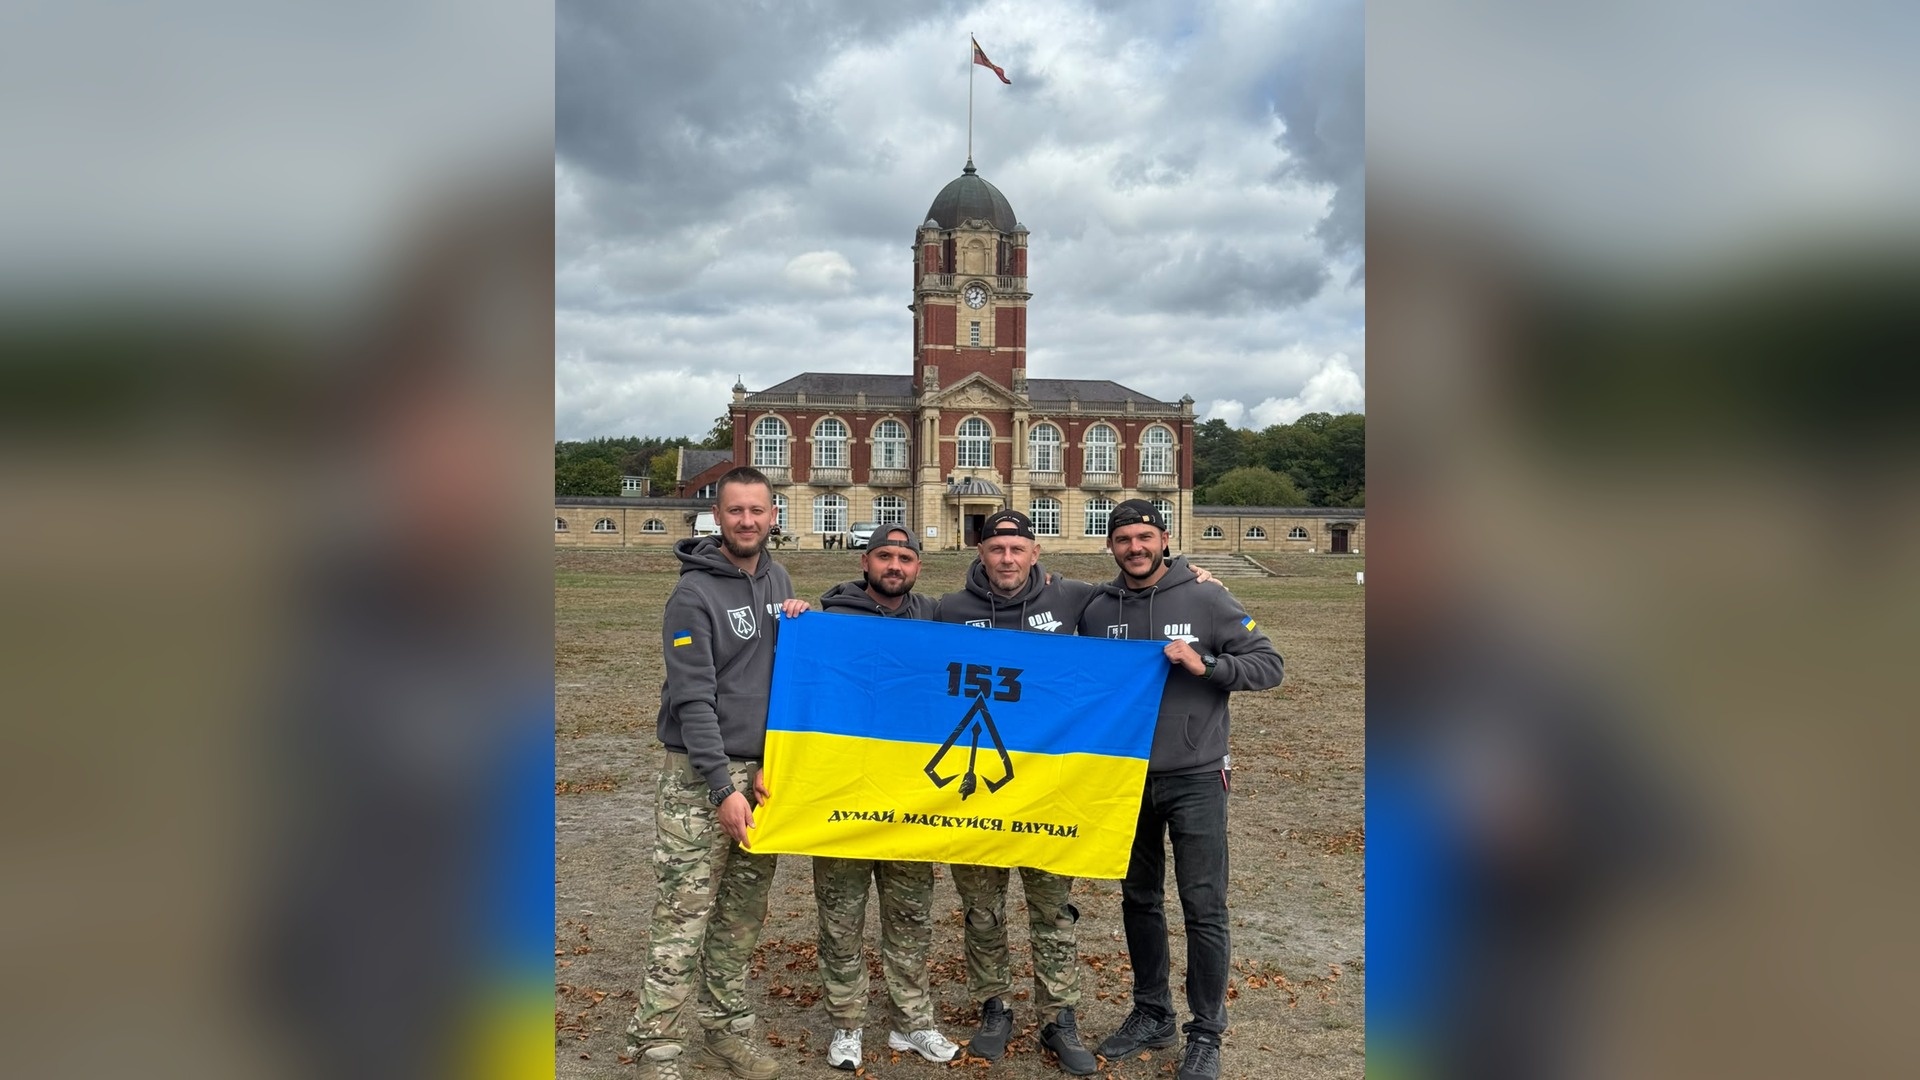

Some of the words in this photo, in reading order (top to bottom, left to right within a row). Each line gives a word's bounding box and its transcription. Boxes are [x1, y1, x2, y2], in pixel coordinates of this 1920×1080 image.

[1028, 611, 1053, 627] ODIN
[1164, 623, 1191, 635] ODIN
[946, 661, 1024, 702] 153
[827, 809, 897, 823] ДУМАЙ.
[901, 813, 1006, 832] МАСКУЙСЯ.
[1011, 820, 1080, 838] ВЛУЧАЙ.
